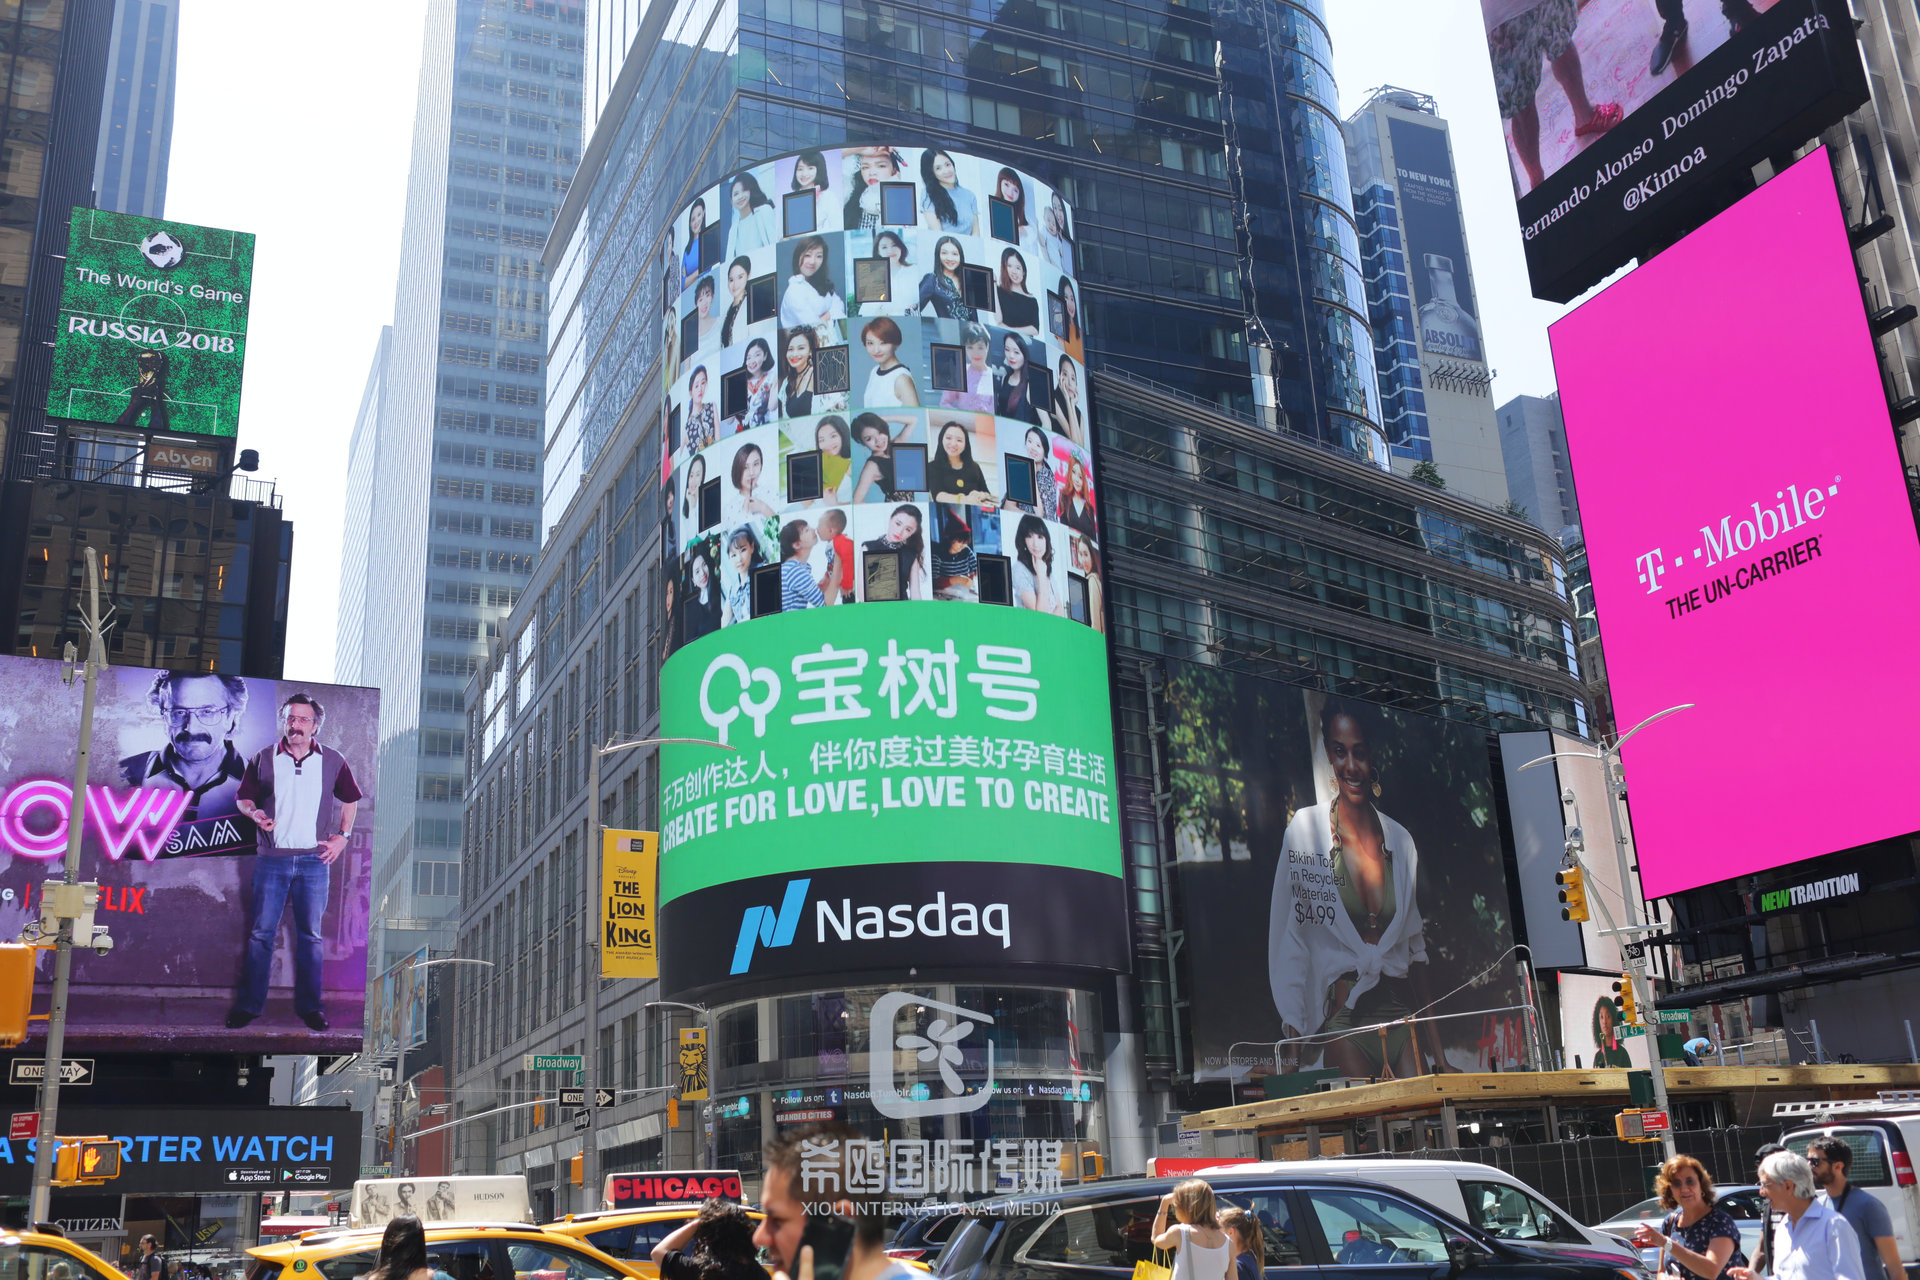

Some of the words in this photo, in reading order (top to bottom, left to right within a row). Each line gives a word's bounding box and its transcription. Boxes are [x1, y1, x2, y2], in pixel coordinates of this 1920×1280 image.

[1594, 137, 1654, 191] Alonso
[1661, 68, 1748, 140] Domingo
[1752, 11, 1829, 73] Zapata
[1396, 168, 1408, 178] TO
[1409, 170, 1427, 182] NEW
[1623, 144, 1707, 212] @Kimoa
[76, 267, 111, 286] The
[118, 273, 184, 296] World’s
[190, 284, 243, 304] Game
[68, 316, 169, 347] RUSSIA
[175, 331, 235, 353] 2018
[153, 449, 212, 469] Absen
[1665, 588, 1702, 620] THE
[1703, 536, 1822, 604] UN-CARRIER
[790, 637, 1041, 726] 宝树号
[663, 804, 717, 854] CREATE
[725, 789, 777, 830] FOR
[976, 776, 1015, 808] TO
[1024, 780, 1110, 824] CREATE
[1288, 850, 1315, 866] Bikini
[1316, 853, 1336, 871] Top
[613, 881, 639, 894] THE
[1290, 867, 1300, 881] in
[1301, 868, 1346, 888] Recycled
[1292, 884, 1337, 903] Materials
[609, 896, 645, 920] LION
[1294, 901, 1336, 926] $4.99
[816, 891, 1010, 949] Nasdaq
[606, 921, 651, 948] KING
[1660, 1011, 1689, 1022] Broadway
[1620, 1028, 1628, 1036] W
[536, 1056, 580, 1069] Broadway
[1204, 1057, 1221, 1065] NOW
[1231, 1057, 1258, 1066] STORES
[1260, 1057, 1274, 1066] AND
[1280, 1058, 1299, 1066] NLINE
[567, 1094, 583, 1102] ONE
[596, 1094, 607, 1102] AY
[781, 1096, 803, 1105] Follow
[804, 1095, 813, 1103] us
[776, 1111, 807, 1123] BRANDED
[808, 1110, 833, 1120] CITIES
[212, 1136, 333, 1162] WATCH
[240, 1174, 254, 1182] App
[295, 1173, 315, 1181] Google
[316, 1173, 327, 1181] Play
[361, 1166, 390, 1175] BROADWAY
[473, 1193, 505, 1201] HUDSON
[614, 1176, 741, 1199] CHICAGO
[56, 1217, 121, 1232] CITIZEN
